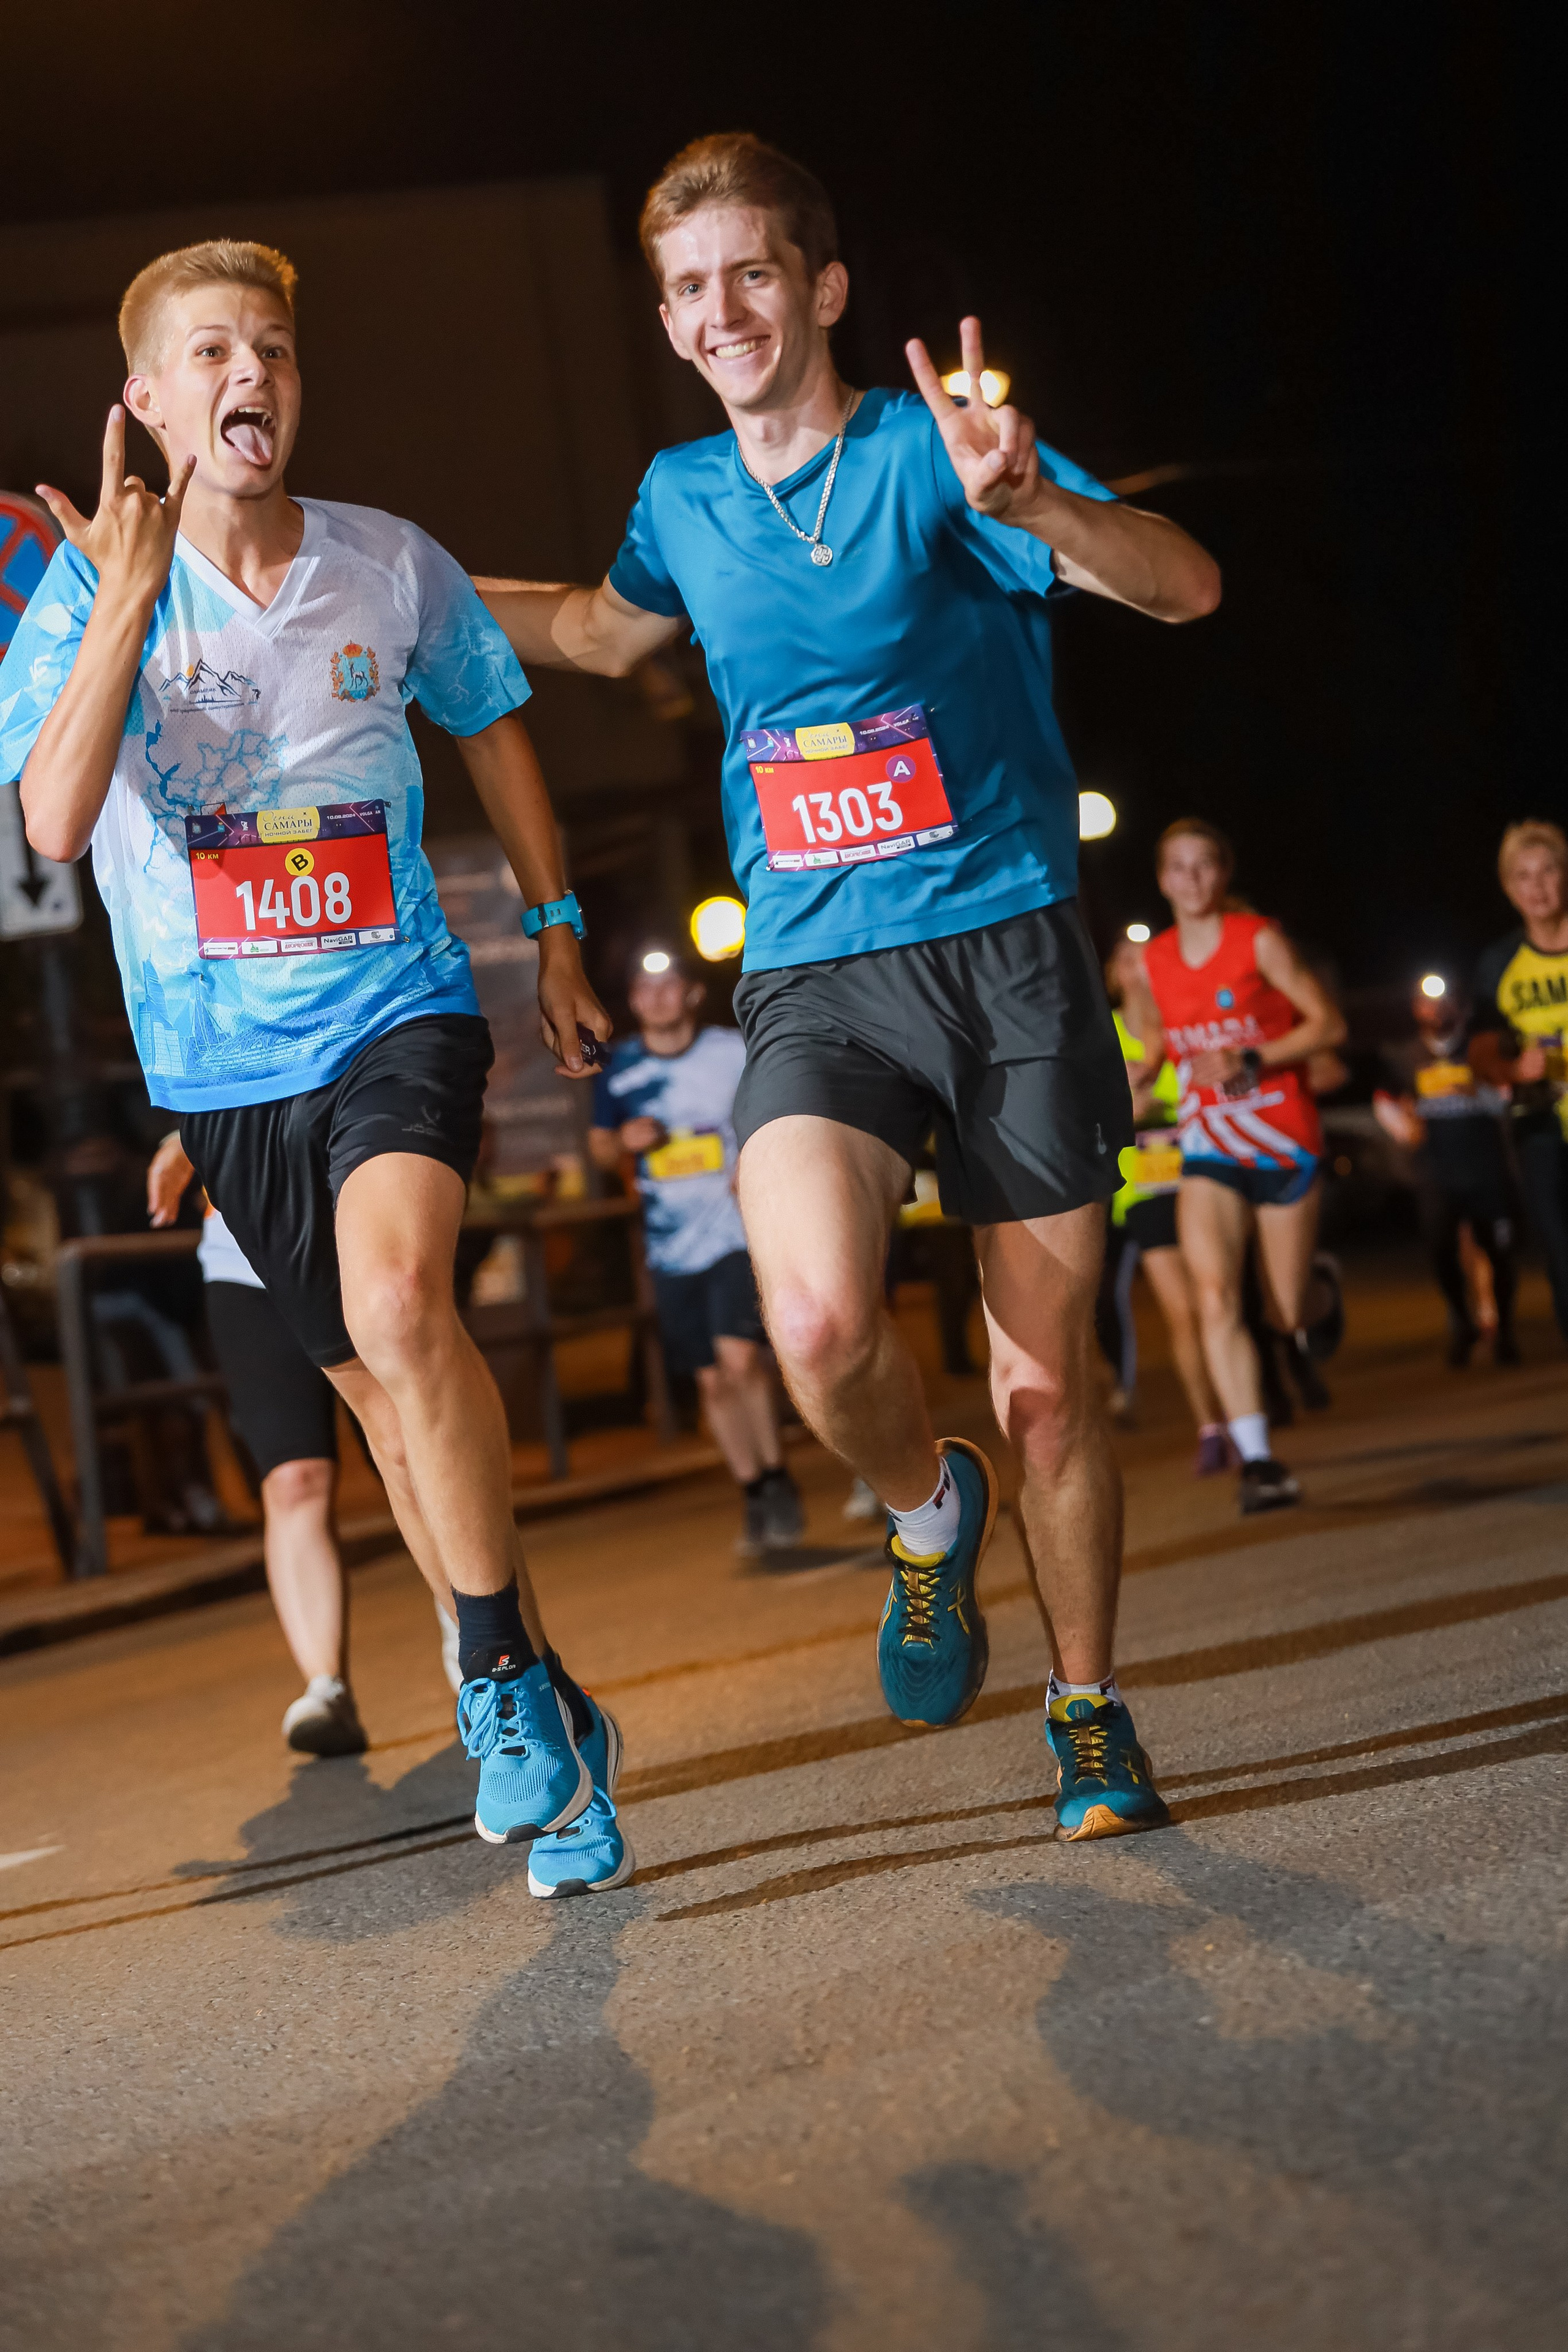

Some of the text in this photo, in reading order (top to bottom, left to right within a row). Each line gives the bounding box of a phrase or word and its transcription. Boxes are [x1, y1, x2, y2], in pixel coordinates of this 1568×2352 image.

[803, 735, 847, 747] САМАРЫ
[264, 819, 312, 831] САМАРЫ
[791, 780, 903, 843] 1303
[235, 871, 353, 931] 1408
